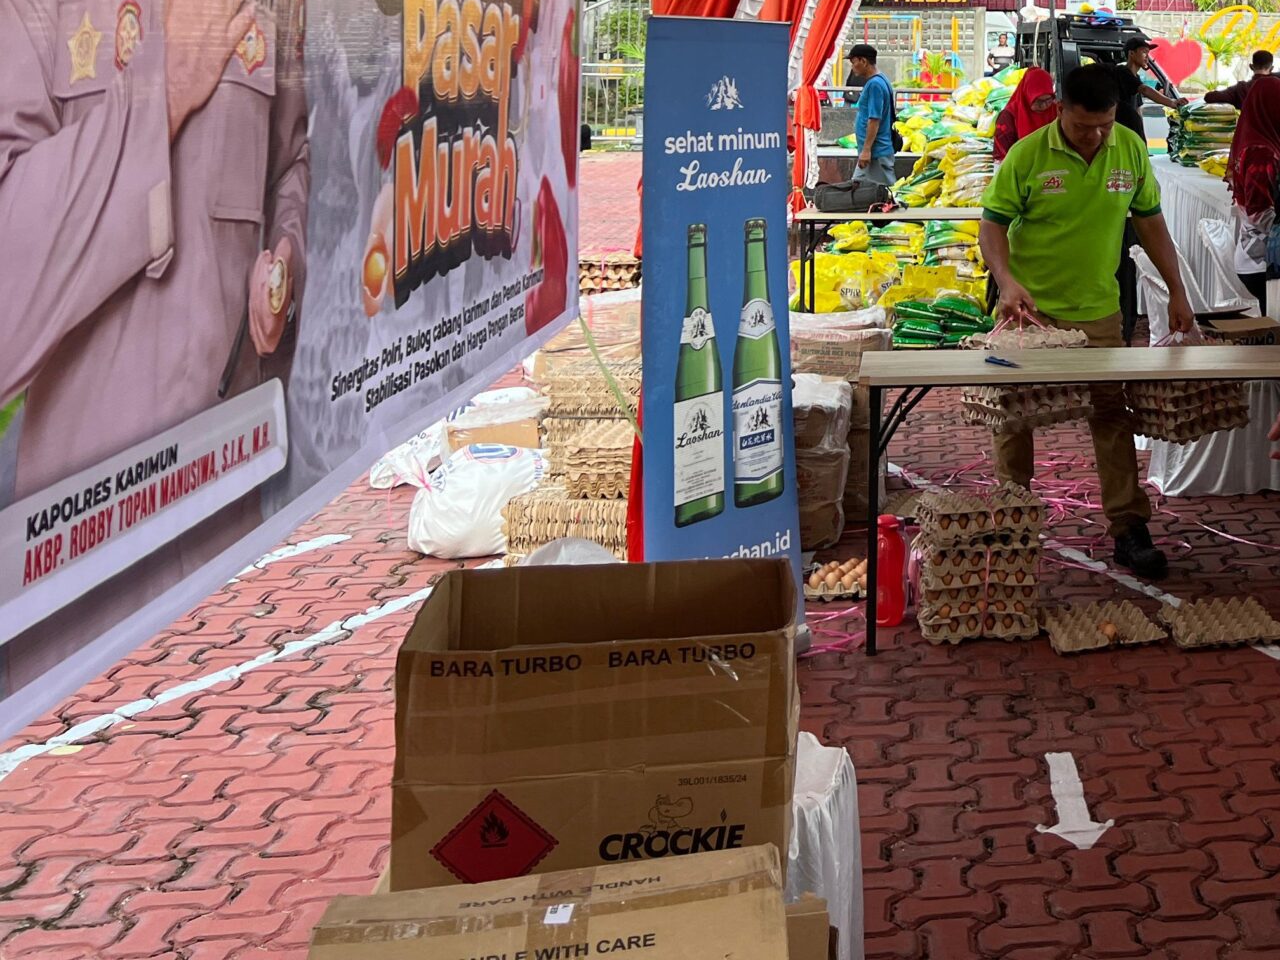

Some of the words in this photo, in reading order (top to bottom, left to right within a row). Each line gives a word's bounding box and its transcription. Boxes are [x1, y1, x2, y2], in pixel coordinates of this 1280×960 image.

[664, 130, 713, 154] sehat
[719, 127, 780, 151] minum
[676, 157, 772, 192] Laoshan
[394, 114, 518, 280] Murah
[331, 355, 380, 401] Sinergitas
[380, 337, 403, 372] Polri,
[406, 328, 431, 356] Bulog
[433, 313, 461, 341] cabang
[491, 291, 502, 310] dan
[365, 362, 412, 412] Stabilisasi
[414, 348, 450, 382] Pasokan
[452, 341, 466, 361] dan
[467, 327, 487, 352] Harga
[488, 314, 508, 341] Pangan
[675, 424, 724, 449] Laoshan
[26, 476, 111, 541] KAPOLRES
[115, 443, 178, 494] KARIMUN
[22, 534, 65, 587] AKBP.
[70, 510, 113, 560] ROBBY
[118, 482, 156, 532] TOPAN
[430, 660, 494, 677] BARA
[500, 654, 582, 676] TURBO
[608, 649, 672, 668] BARA
[677, 642, 756, 664] TURBO
[598, 823, 746, 861] CROCKIE
[522, 889, 574, 902] WITH
[580, 875, 661, 895] HANDLE
[458, 896, 520, 909] CARE
[534, 942, 589, 959] WITH
[596, 933, 656, 954] CARE
